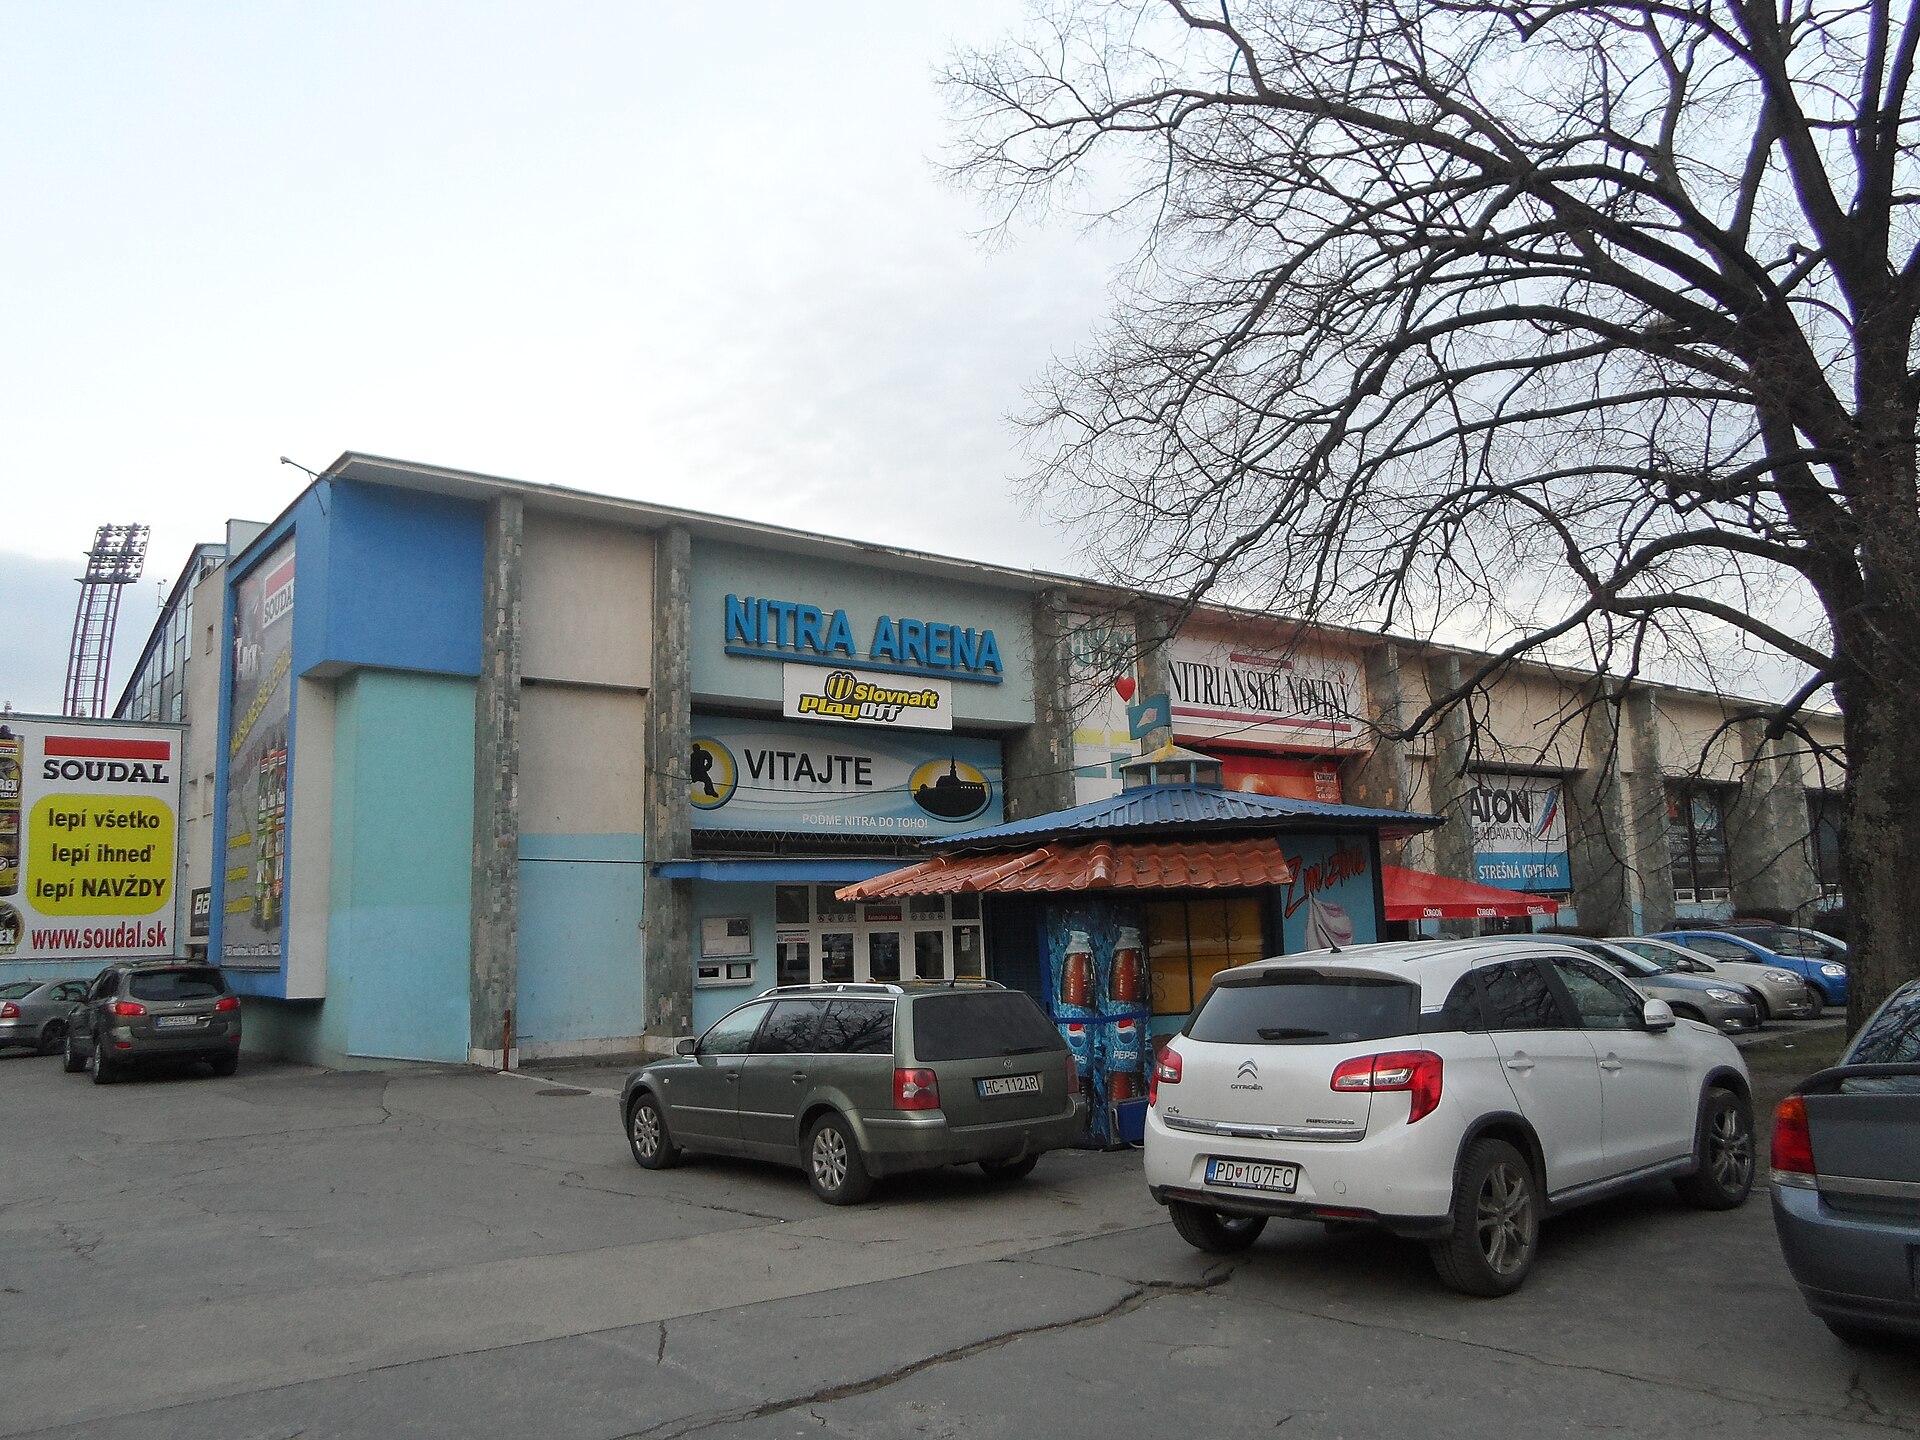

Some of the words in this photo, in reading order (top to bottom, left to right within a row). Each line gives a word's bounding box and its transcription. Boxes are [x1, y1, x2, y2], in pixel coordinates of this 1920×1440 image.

[264, 589, 294, 623] SOUDA
[724, 594, 856, 655] NITRA
[871, 615, 1003, 672] ARENA
[853, 684, 938, 707] Slovnaft
[1168, 660, 1282, 712] NITRIANSKE
[43, 760, 170, 783] SOUDAL
[744, 749, 873, 785] VITAJTE
[48, 808, 87, 832] lepí
[94, 809, 160, 829] všetko
[844, 815, 877, 827] NITRA
[878, 816, 894, 827] DO
[896, 817, 928, 829] TOHO!
[52, 843, 90, 866] lepí
[97, 844, 155, 863] ihneď
[1479, 861, 1521, 879] STREŠNÁ
[36, 878, 74, 902] lepí
[82, 874, 166, 897] NAVŽDY
[32, 921, 167, 950] www.soudal.sk
[1113, 1050, 1138, 1060] PEPSI
[985, 1076, 1037, 1095] HC-112AR
[1215, 1162, 1234, 1181] PD
[1244, 1164, 1293, 1187] 107FC
